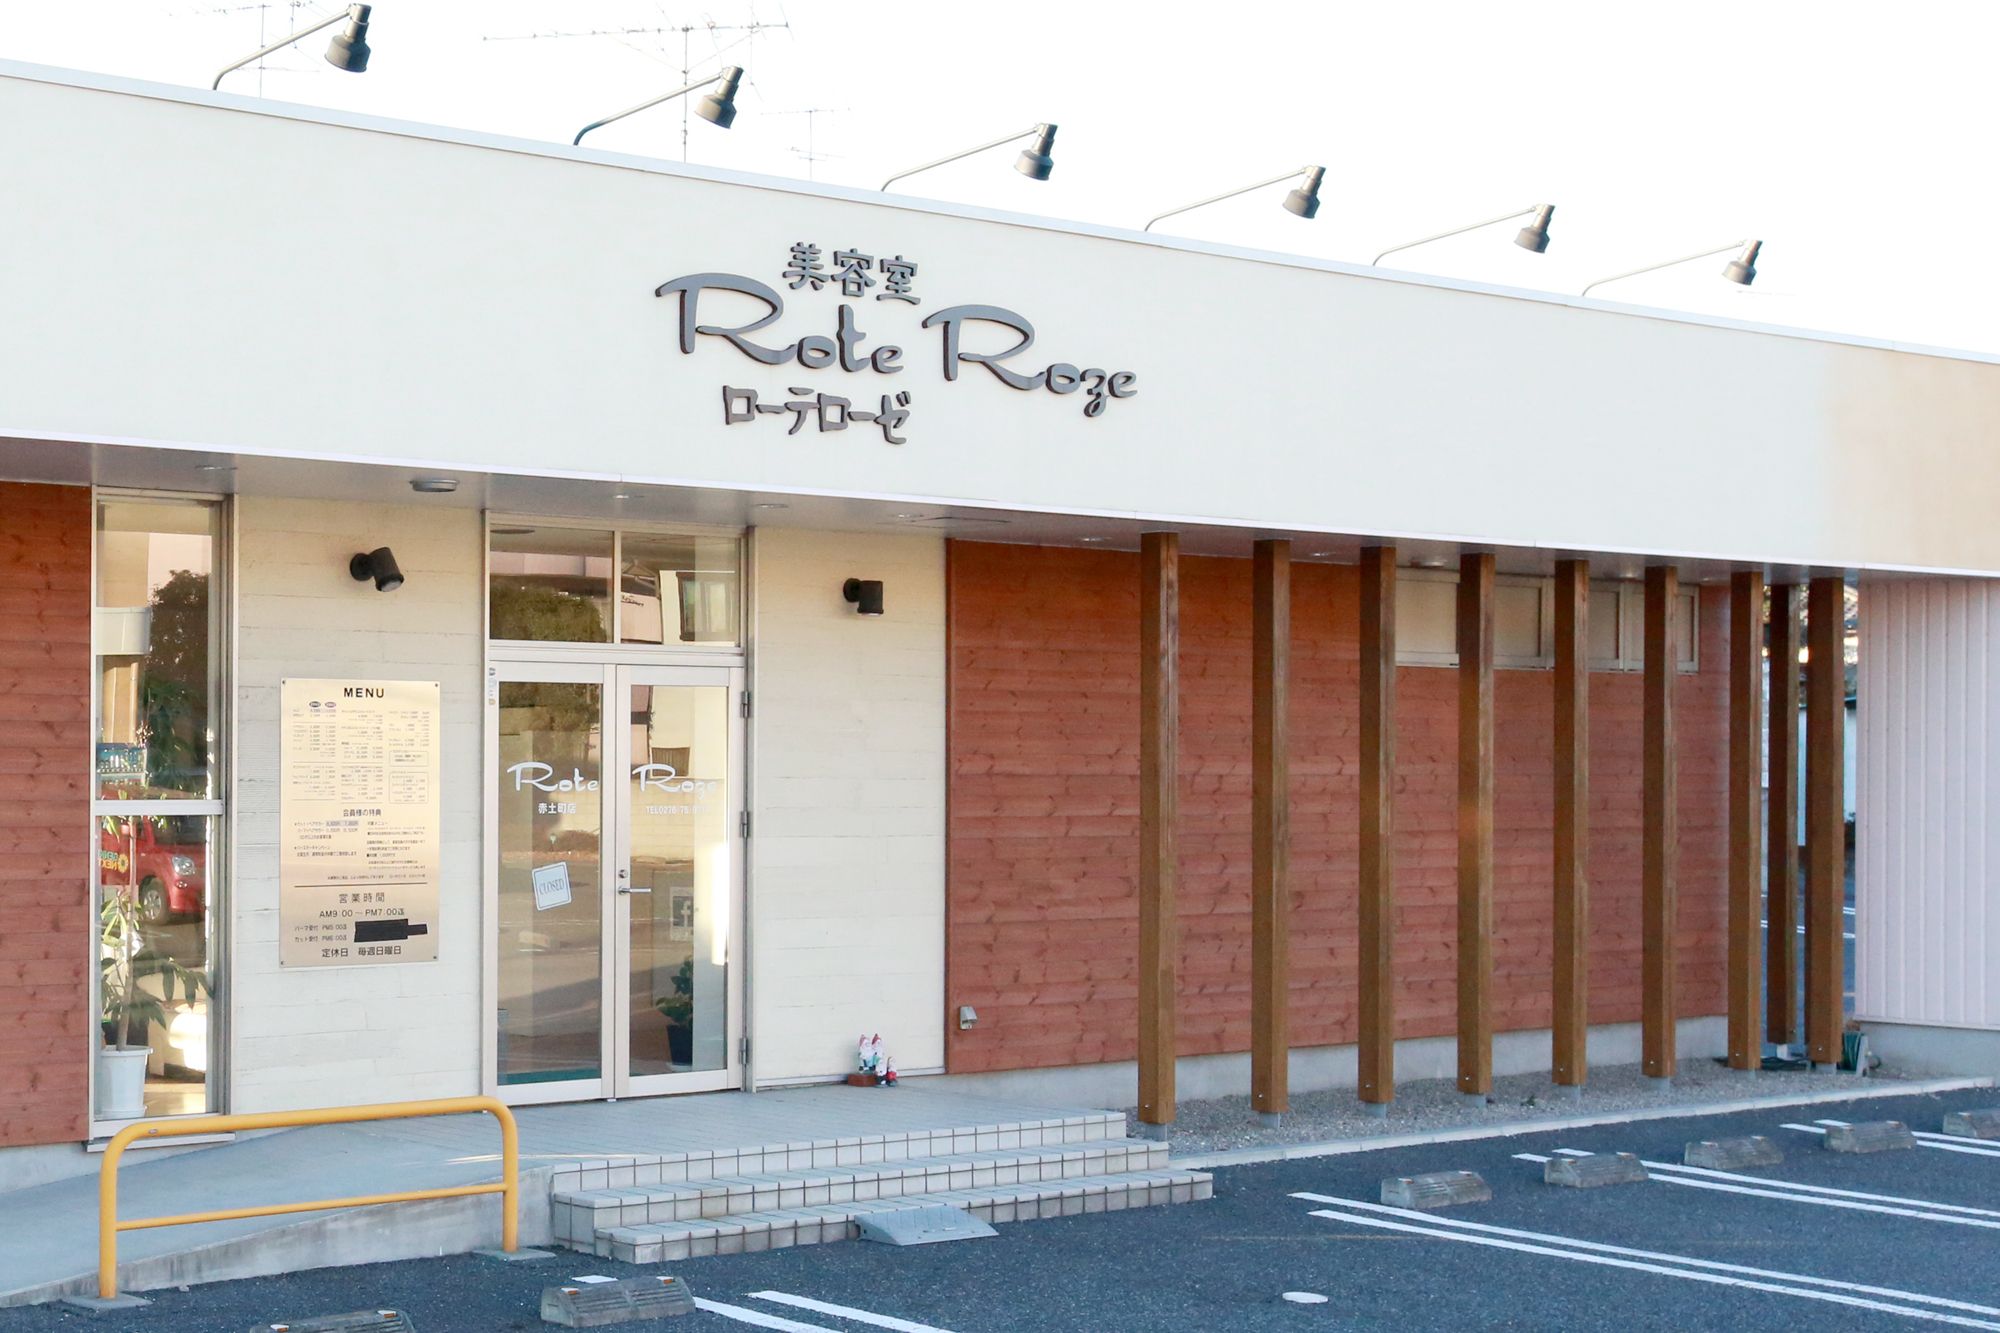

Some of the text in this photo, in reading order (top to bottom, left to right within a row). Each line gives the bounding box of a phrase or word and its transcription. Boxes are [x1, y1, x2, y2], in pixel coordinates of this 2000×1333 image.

[782, 242, 921, 306] 美容室
[655, 272, 1138, 418] Rote Roze
[722, 384, 912, 446] ローテローゼ
[343, 687, 385, 698] MENU
[506, 761, 599, 793] Rote
[339, 892, 385, 904] 営業時間
[538, 878, 565, 895] CLOSED
[321, 945, 402, 958] 定休日 毎週日曜日
